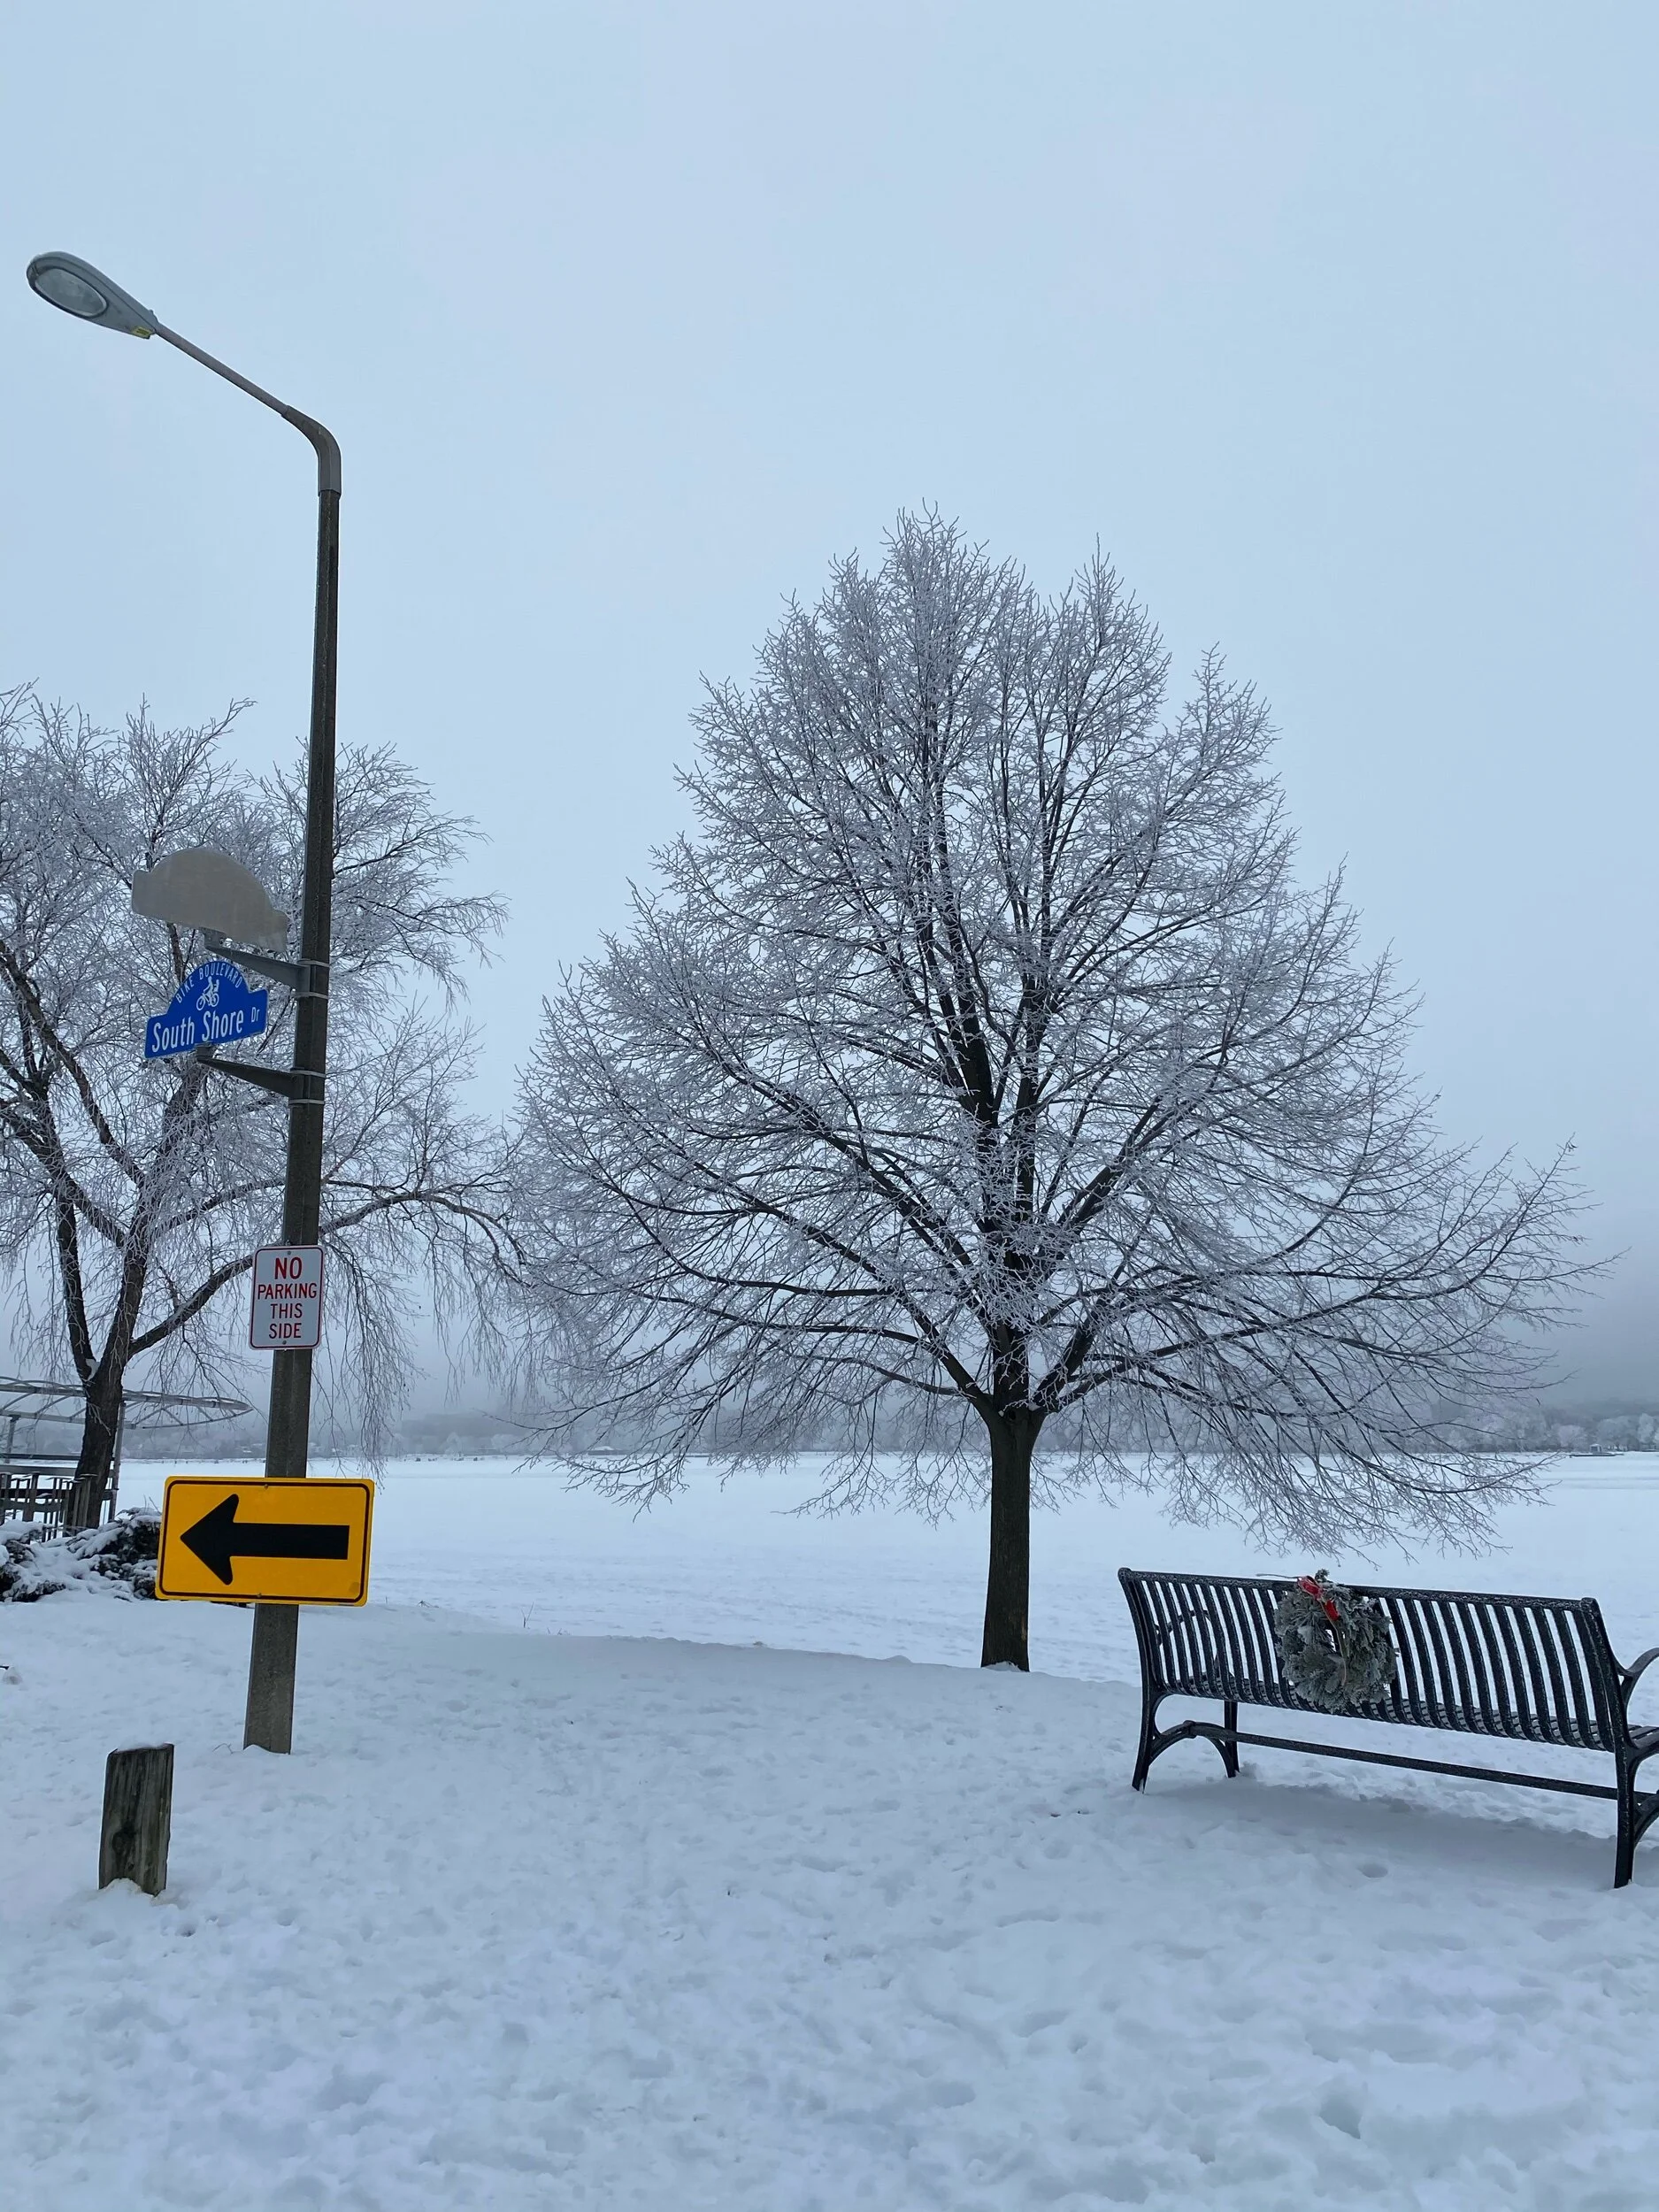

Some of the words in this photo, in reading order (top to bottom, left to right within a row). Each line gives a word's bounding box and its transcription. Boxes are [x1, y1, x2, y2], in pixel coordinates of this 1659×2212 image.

[175, 975, 195, 1003] BIKE
[198, 962, 243, 988] BOULEVARD
[151, 1016, 195, 1053] South
[202, 1010, 244, 1042] Shore
[250, 1007, 260, 1023] Dr
[274, 1256, 303, 1279] NO
[257, 1283, 318, 1300] PARKING
[270, 1302, 303, 1319] THIS
[268, 1323, 303, 1339] SIDE
